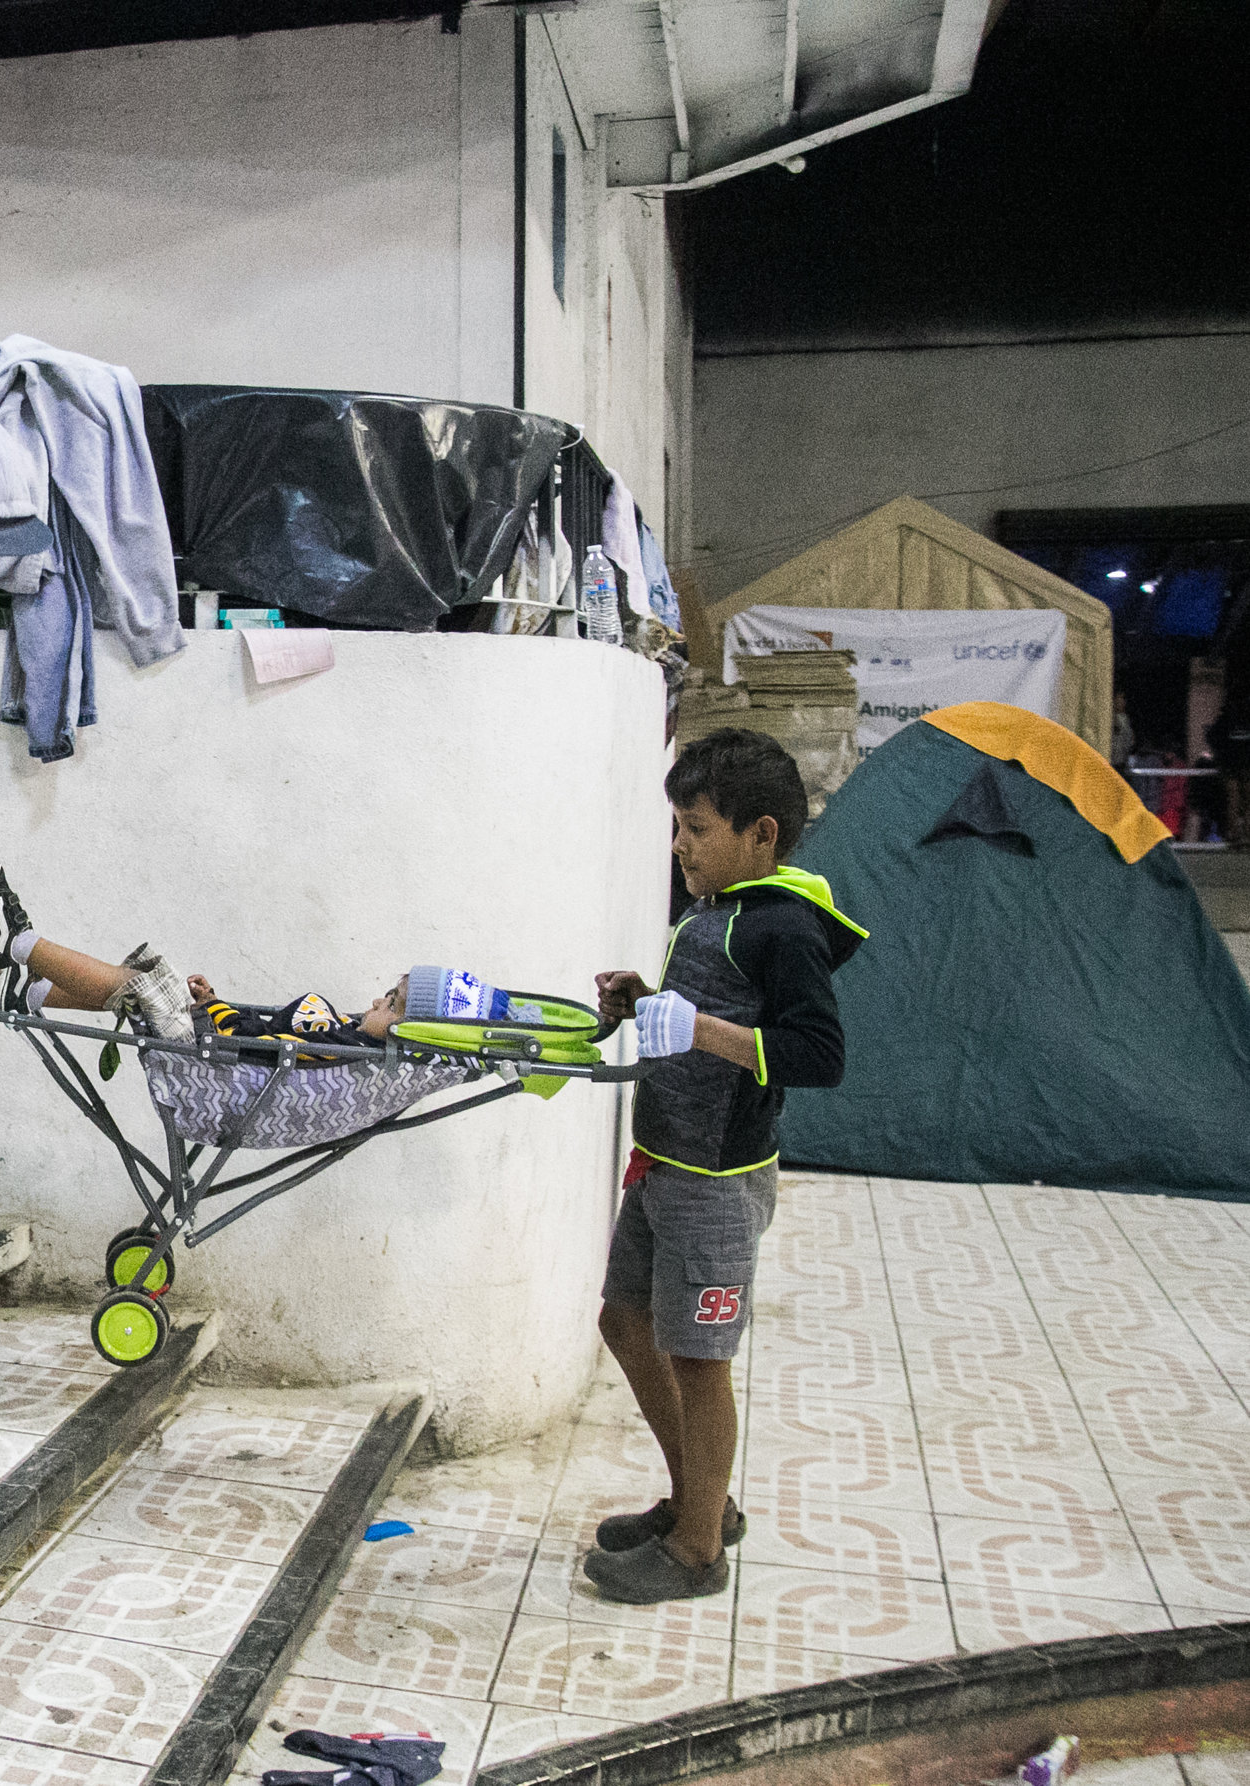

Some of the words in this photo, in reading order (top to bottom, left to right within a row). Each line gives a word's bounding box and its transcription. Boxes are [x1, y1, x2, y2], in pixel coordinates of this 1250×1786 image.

[953, 640, 1020, 661] unicef
[860, 701, 938, 721] Amigab
[694, 1284, 744, 1325] 95
